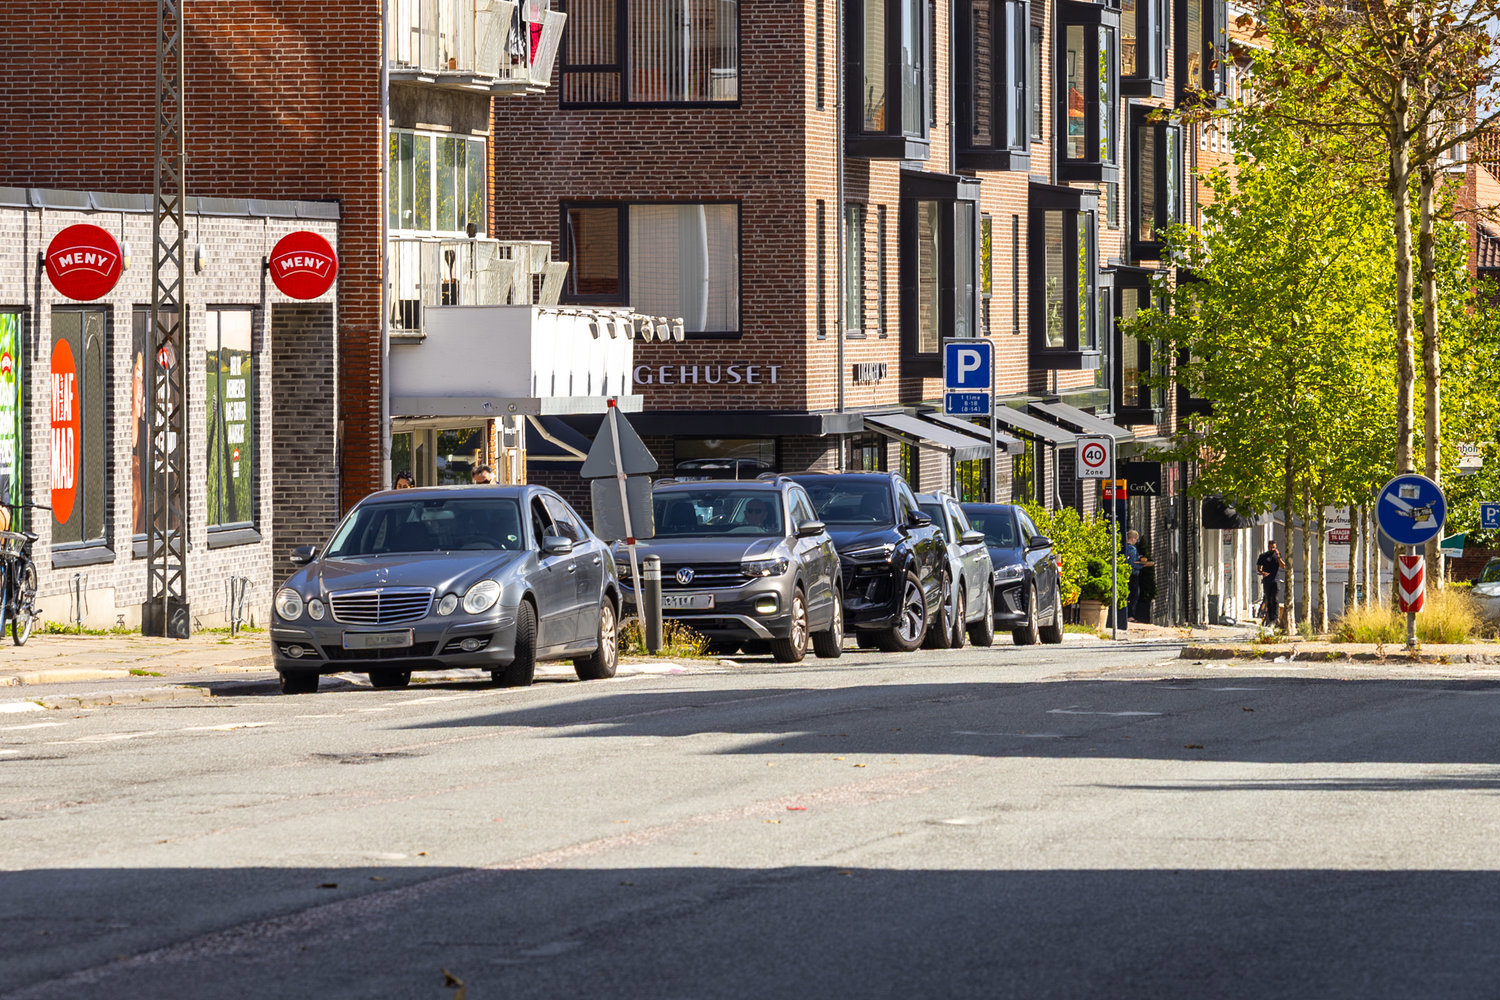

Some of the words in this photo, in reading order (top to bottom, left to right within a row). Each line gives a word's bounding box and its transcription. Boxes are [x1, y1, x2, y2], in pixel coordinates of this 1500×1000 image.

[58, 252, 108, 268] MENY
[280, 256, 325, 271] MENY
[633, 364, 782, 385] GEHUSET
[957, 349, 982, 384] P
[63, 373, 74, 421] AF
[51, 427, 74, 489] MAD
[1086, 450, 1102, 460] 40
[1486, 507, 1497, 520] P
